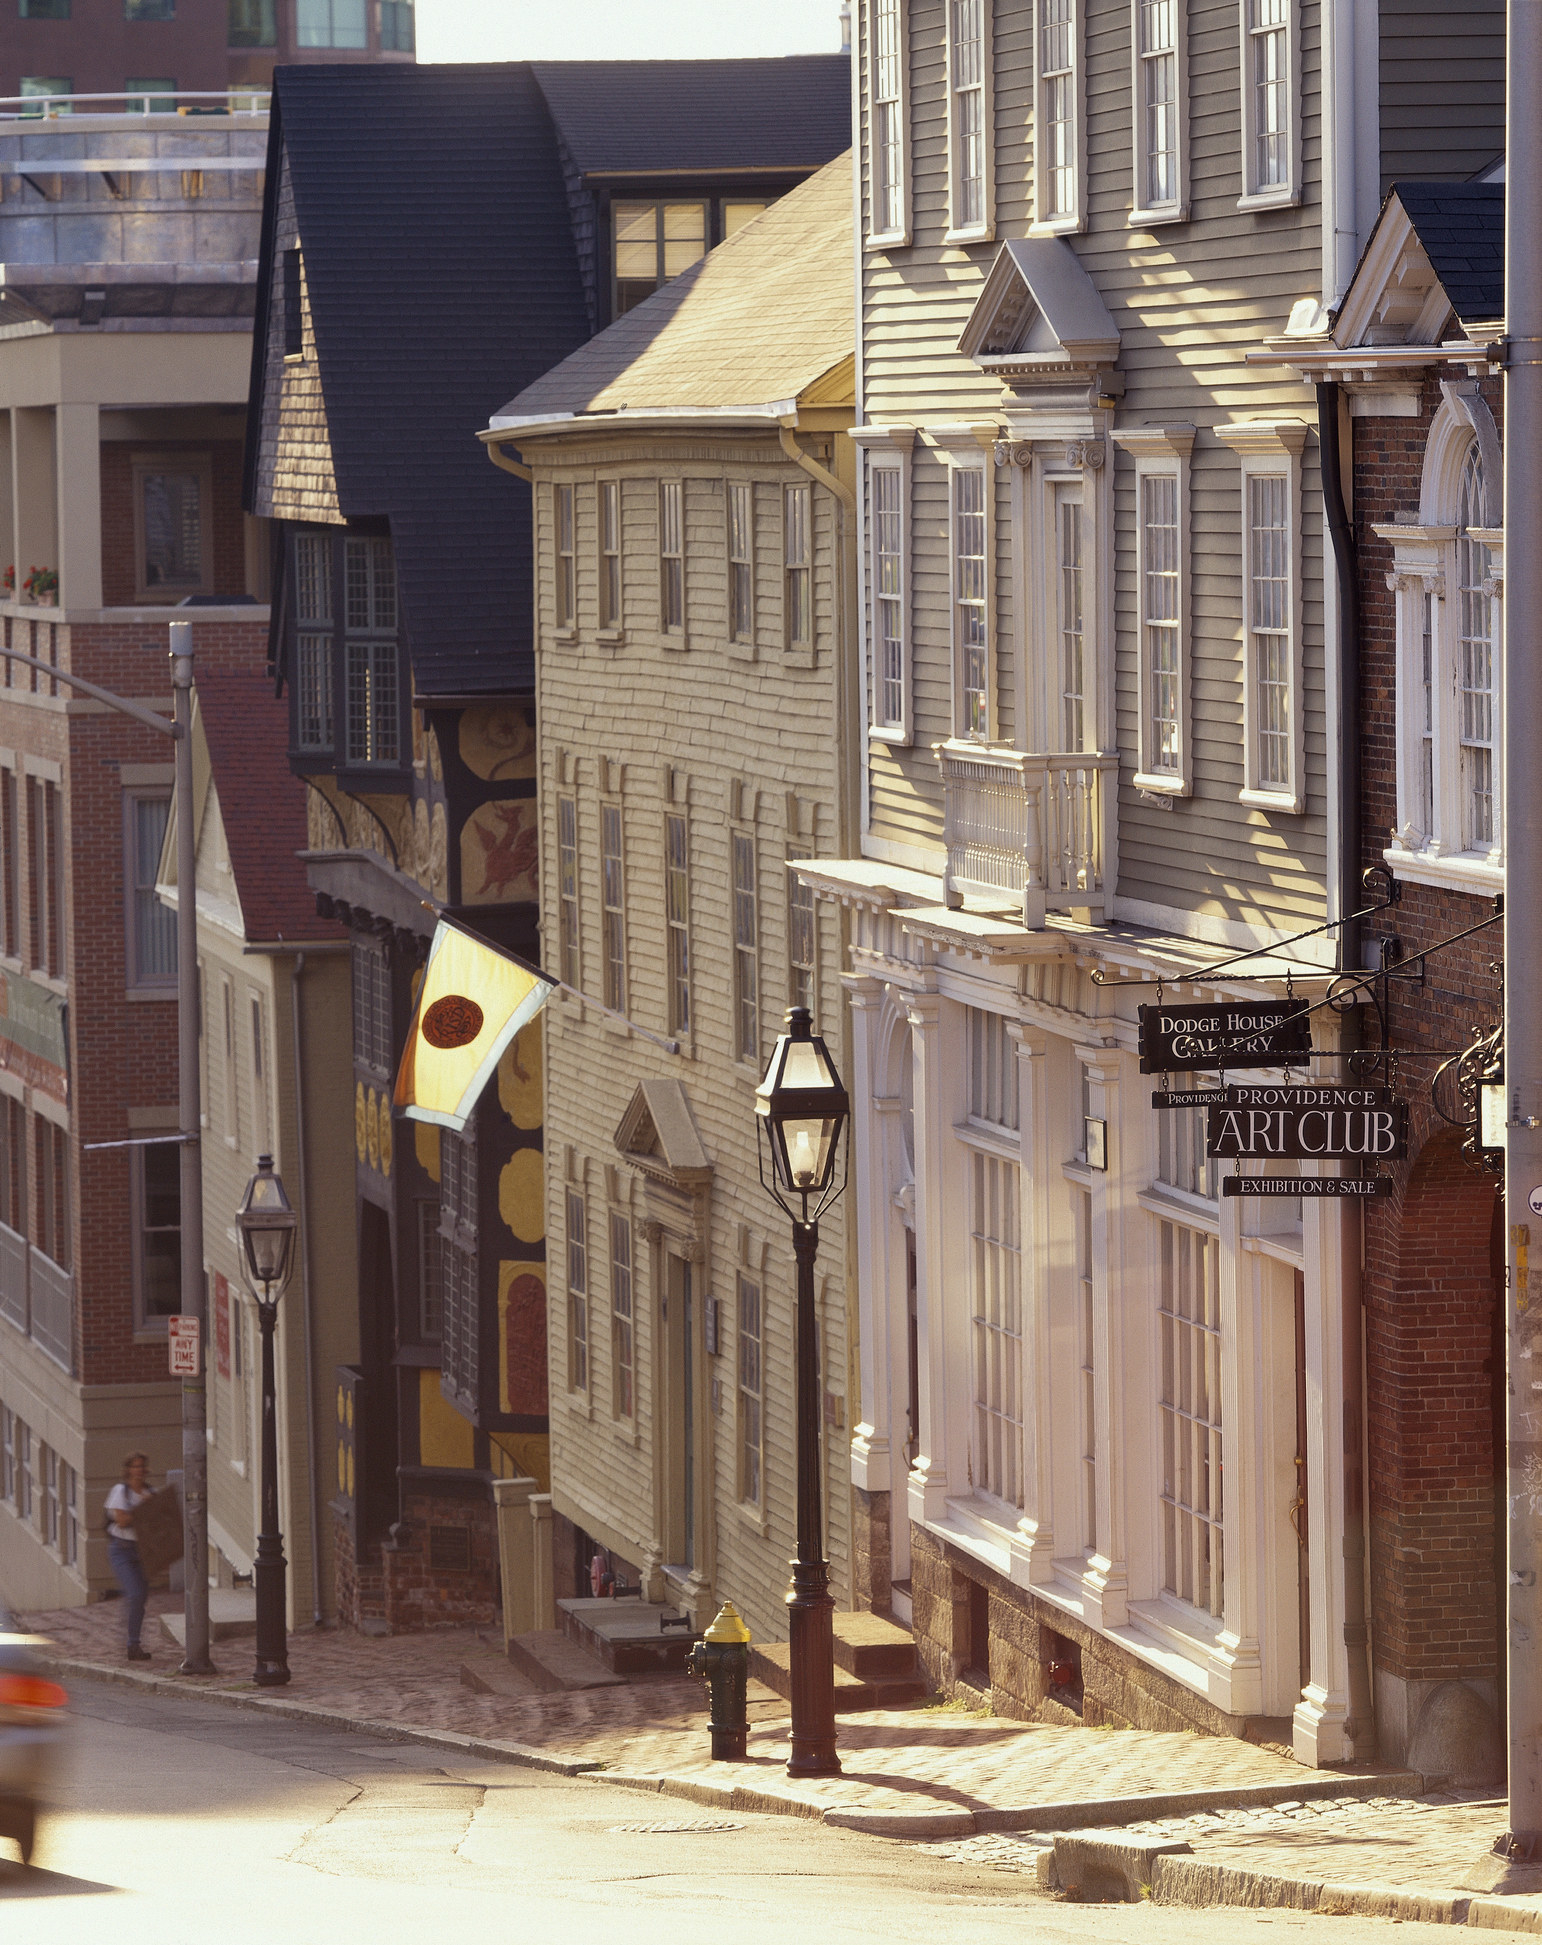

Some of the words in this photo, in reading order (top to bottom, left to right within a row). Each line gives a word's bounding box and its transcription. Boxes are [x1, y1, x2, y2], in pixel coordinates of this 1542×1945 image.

[1160, 1016, 1221, 1034] DODGE
[1227, 1013, 1284, 1031] HOUSE
[1236, 1089, 1376, 1106] PROVIDENCE
[1214, 1110, 1294, 1153] ART
[1298, 1110, 1396, 1154] CLUB
[1240, 1180, 1323, 1194] EXHIBITION
[1326, 1180, 1335, 1193] &
[1339, 1181, 1376, 1194] SALE
[175, 1339, 193, 1350] ANY
[174, 1351, 195, 1363] TIME
